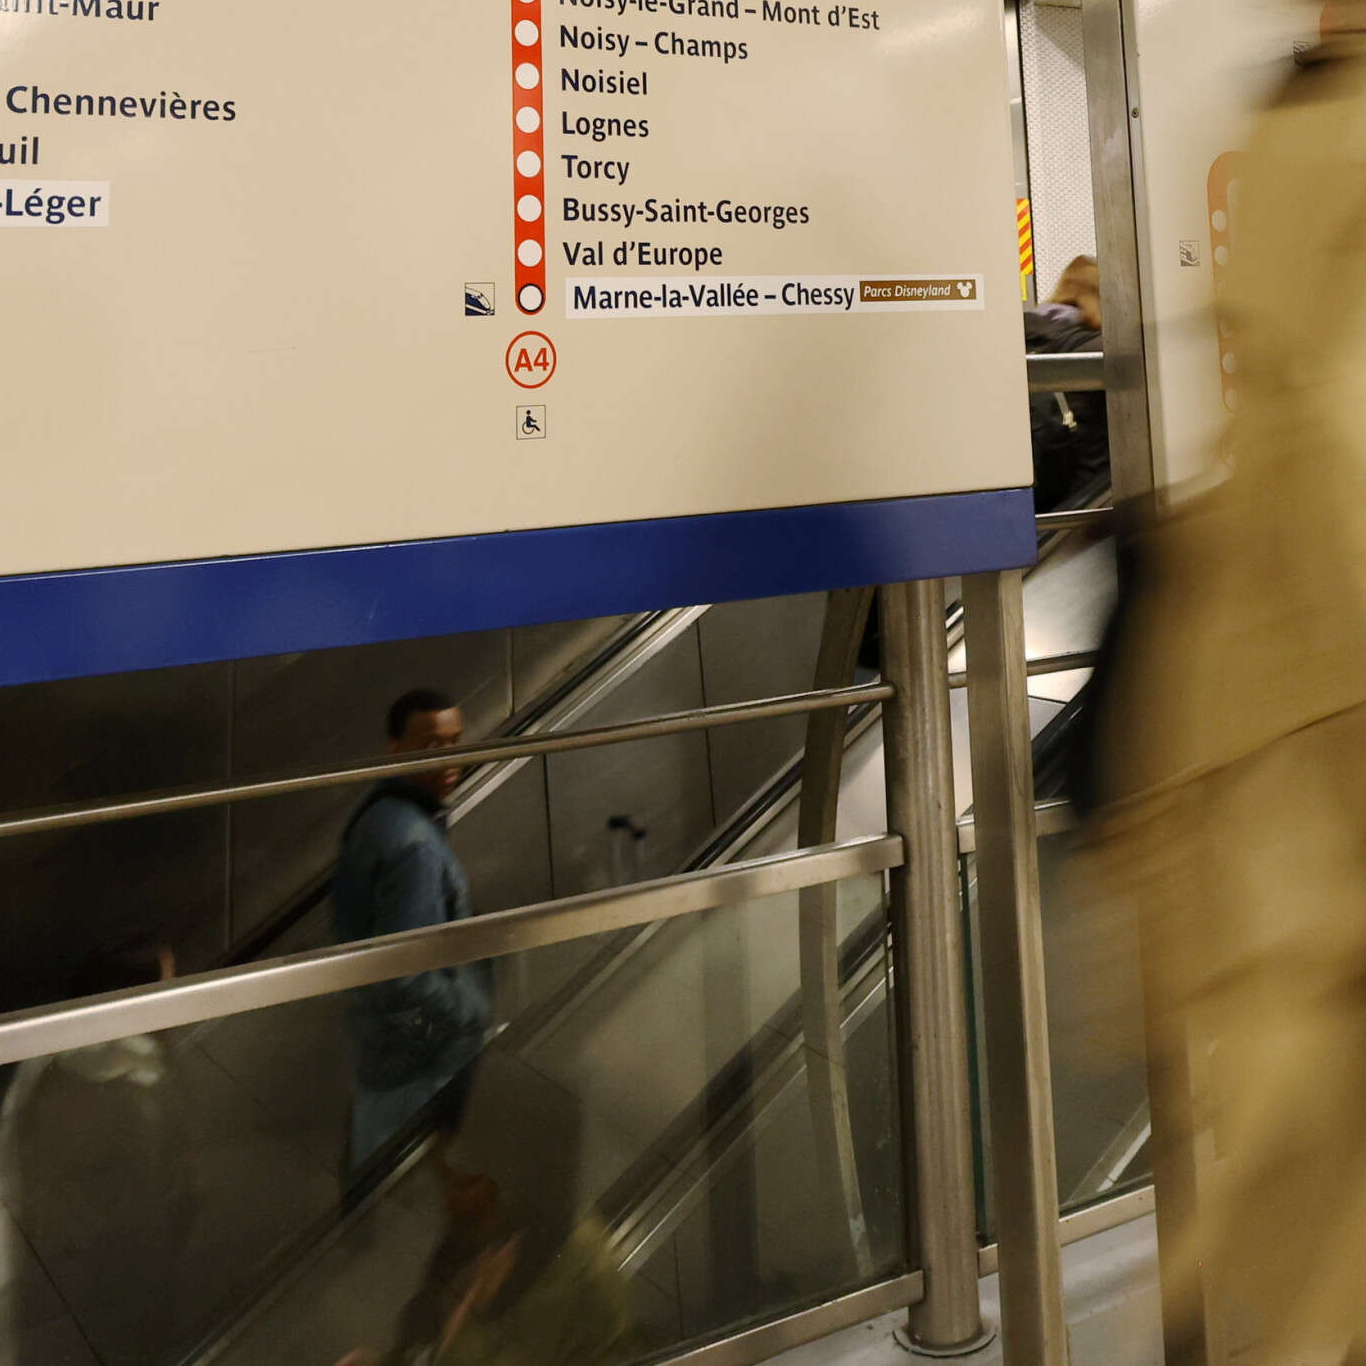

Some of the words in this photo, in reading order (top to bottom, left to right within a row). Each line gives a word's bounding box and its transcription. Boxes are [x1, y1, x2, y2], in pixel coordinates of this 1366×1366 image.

[762, 0, 820, 25] Mont
[560, 25, 629, 57] Noisy
[654, 32, 748, 64] Champs
[561, 68, 648, 95] Noisiel
[6, 86, 235, 121] Chennevières
[562, 111, 649, 142] Lognes
[561, 155, 629, 185] Torcy
[563, 198, 809, 229] Bussy-Saint-Georges
[562, 241, 603, 265] Val
[573, 283, 759, 310] Marne-la-Vallée
[781, 282, 855, 310] Chessy
[863, 285, 892, 298] Parcs
[895, 284, 951, 300] Disneyland
[514, 347, 549, 372] A4
